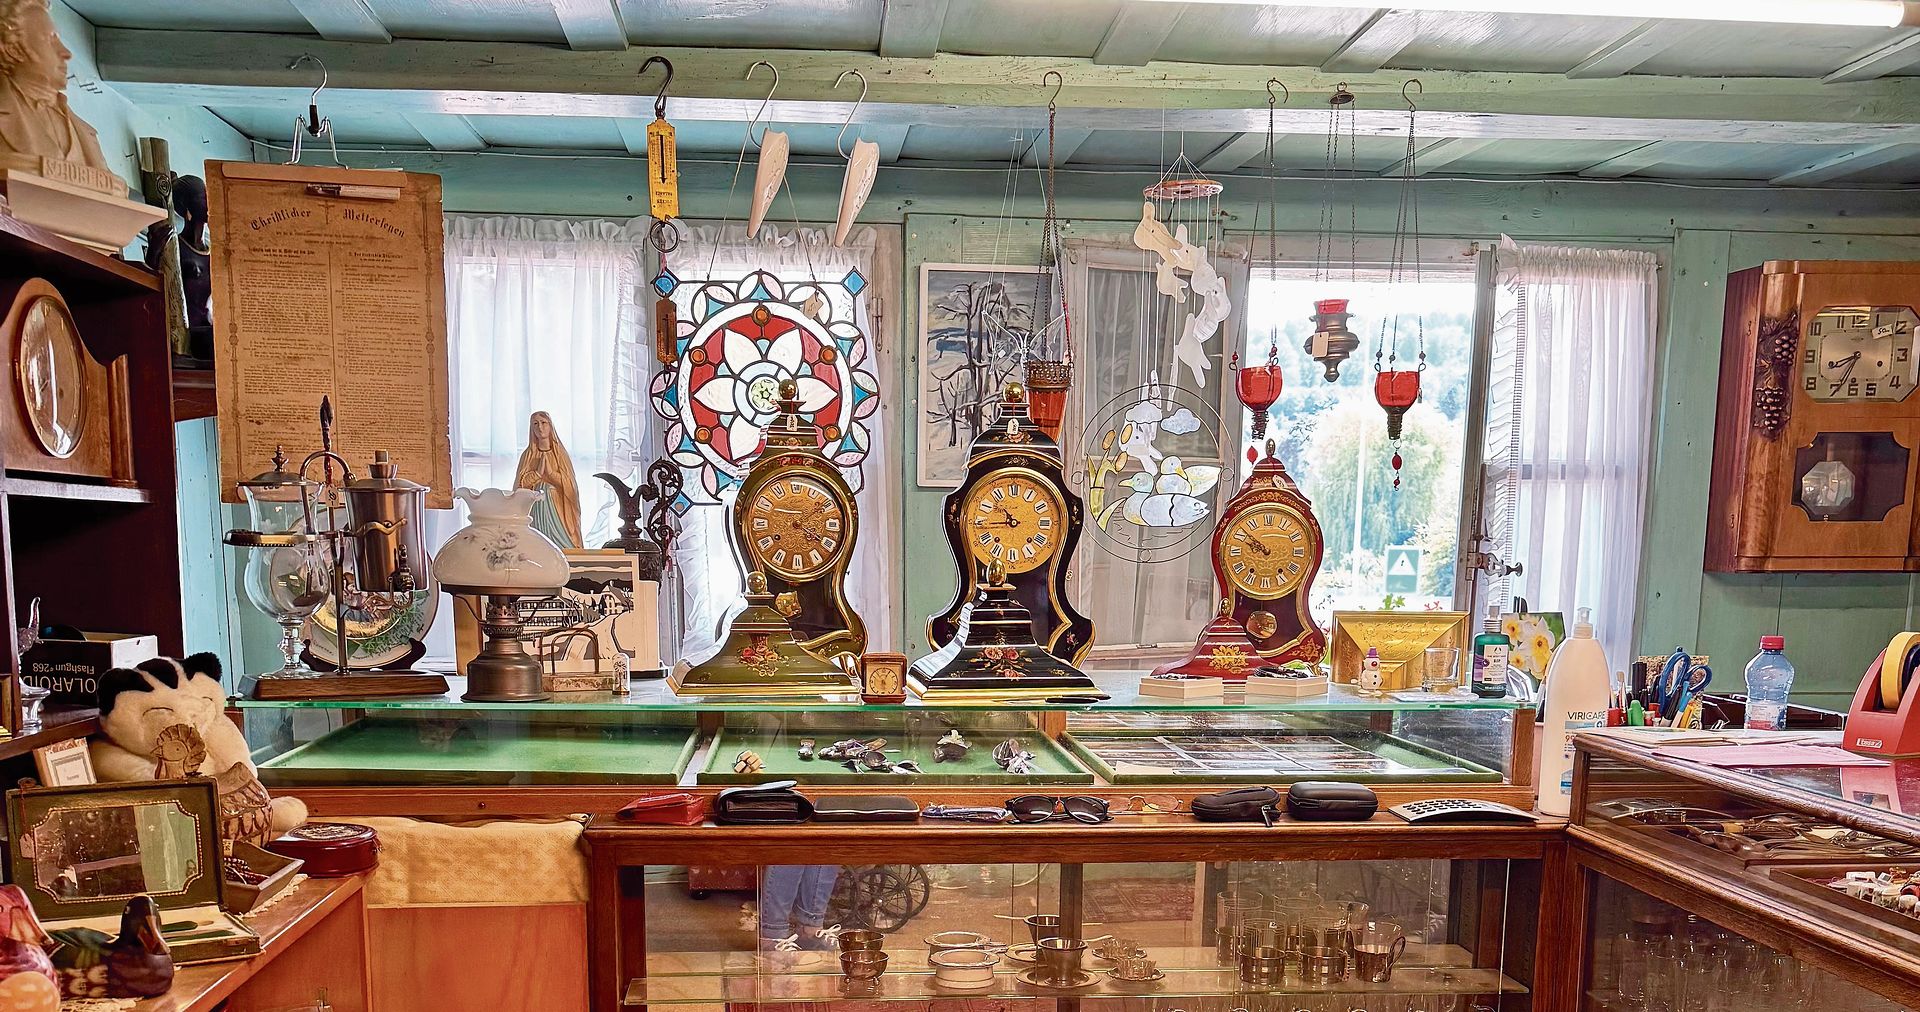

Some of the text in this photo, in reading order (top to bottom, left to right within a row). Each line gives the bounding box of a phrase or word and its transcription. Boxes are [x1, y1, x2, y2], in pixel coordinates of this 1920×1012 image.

[1836, 315, 1844, 328] 11
[1896, 320, 1907, 334] 2
[1810, 322, 1822, 336] 10
[1804, 350, 1816, 364] 9
[1896, 348, 1908, 362] 3
[1806, 376, 1816, 390] 8
[1889, 376, 1902, 389] 4
[1848, 384, 1858, 396] 6
[1866, 383, 1876, 396] 5
[56, 662, 94, 674] Flashgun
[22, 675, 96, 694] OLAROID
[1568, 710, 1606, 720] VIRICARE
